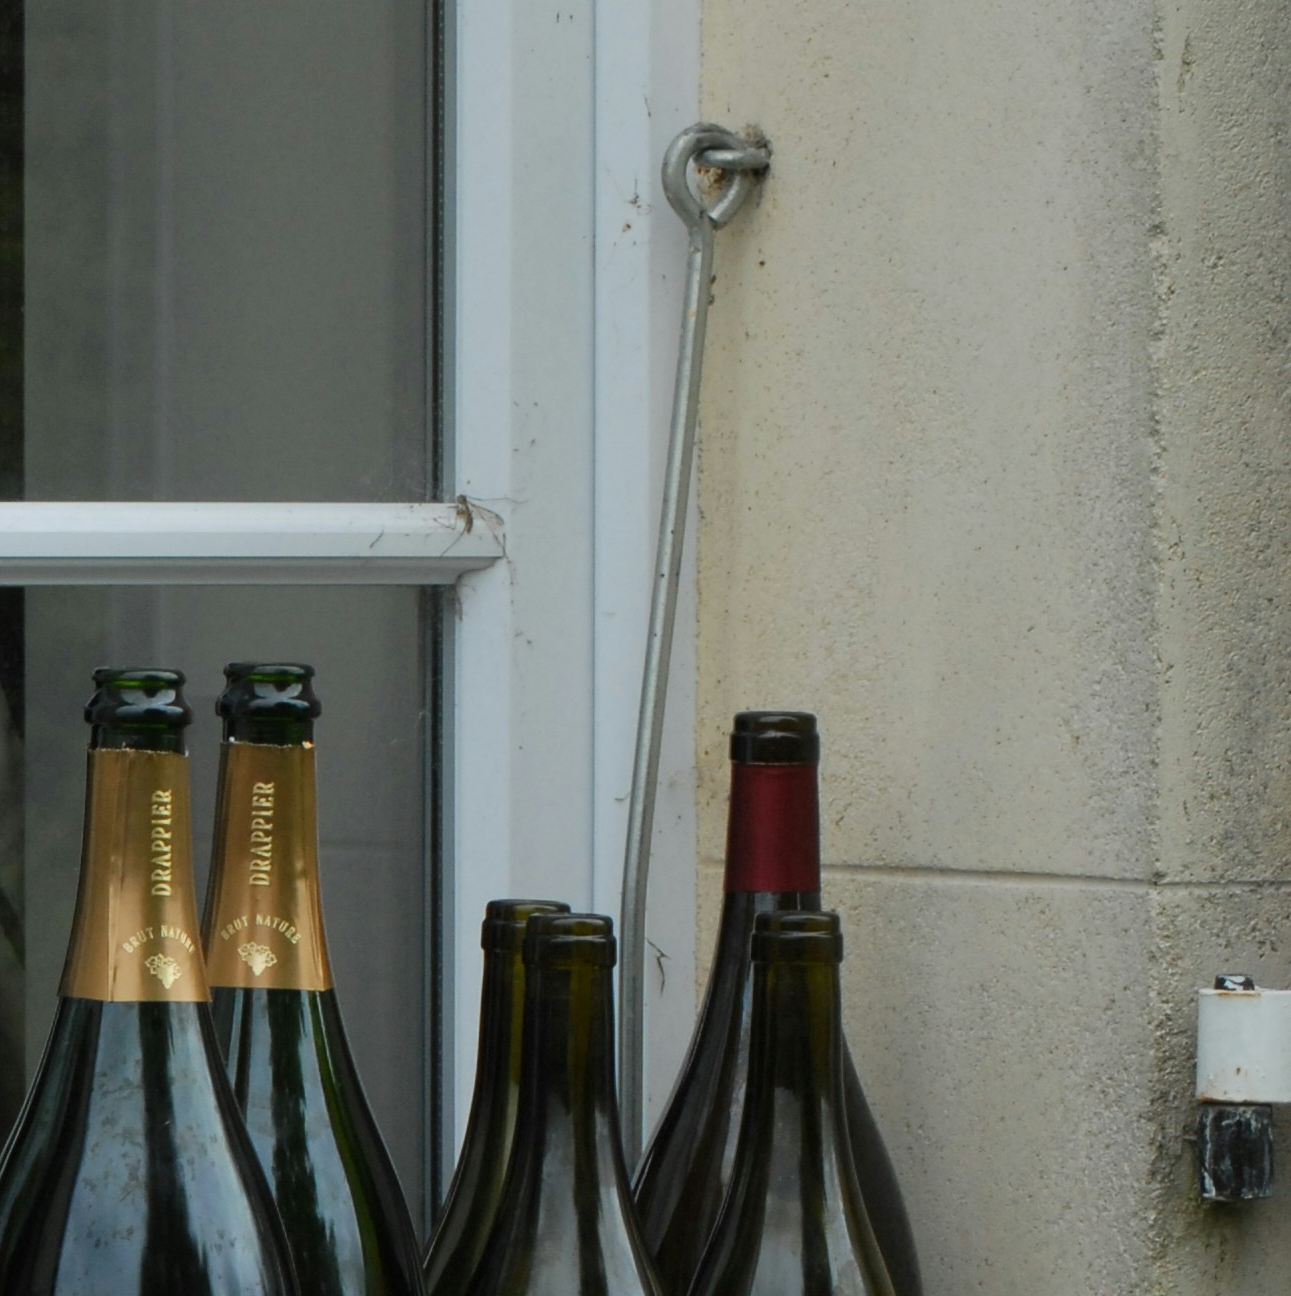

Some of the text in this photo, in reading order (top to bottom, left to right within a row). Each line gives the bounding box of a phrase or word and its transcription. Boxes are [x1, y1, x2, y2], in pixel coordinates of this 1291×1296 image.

[151, 789, 172, 897] DRAPPIER
[250, 781, 275, 887] DRAPPIER
[122, 927, 154, 953] BRUT
[222, 914, 301, 944] BRUT NATURE
